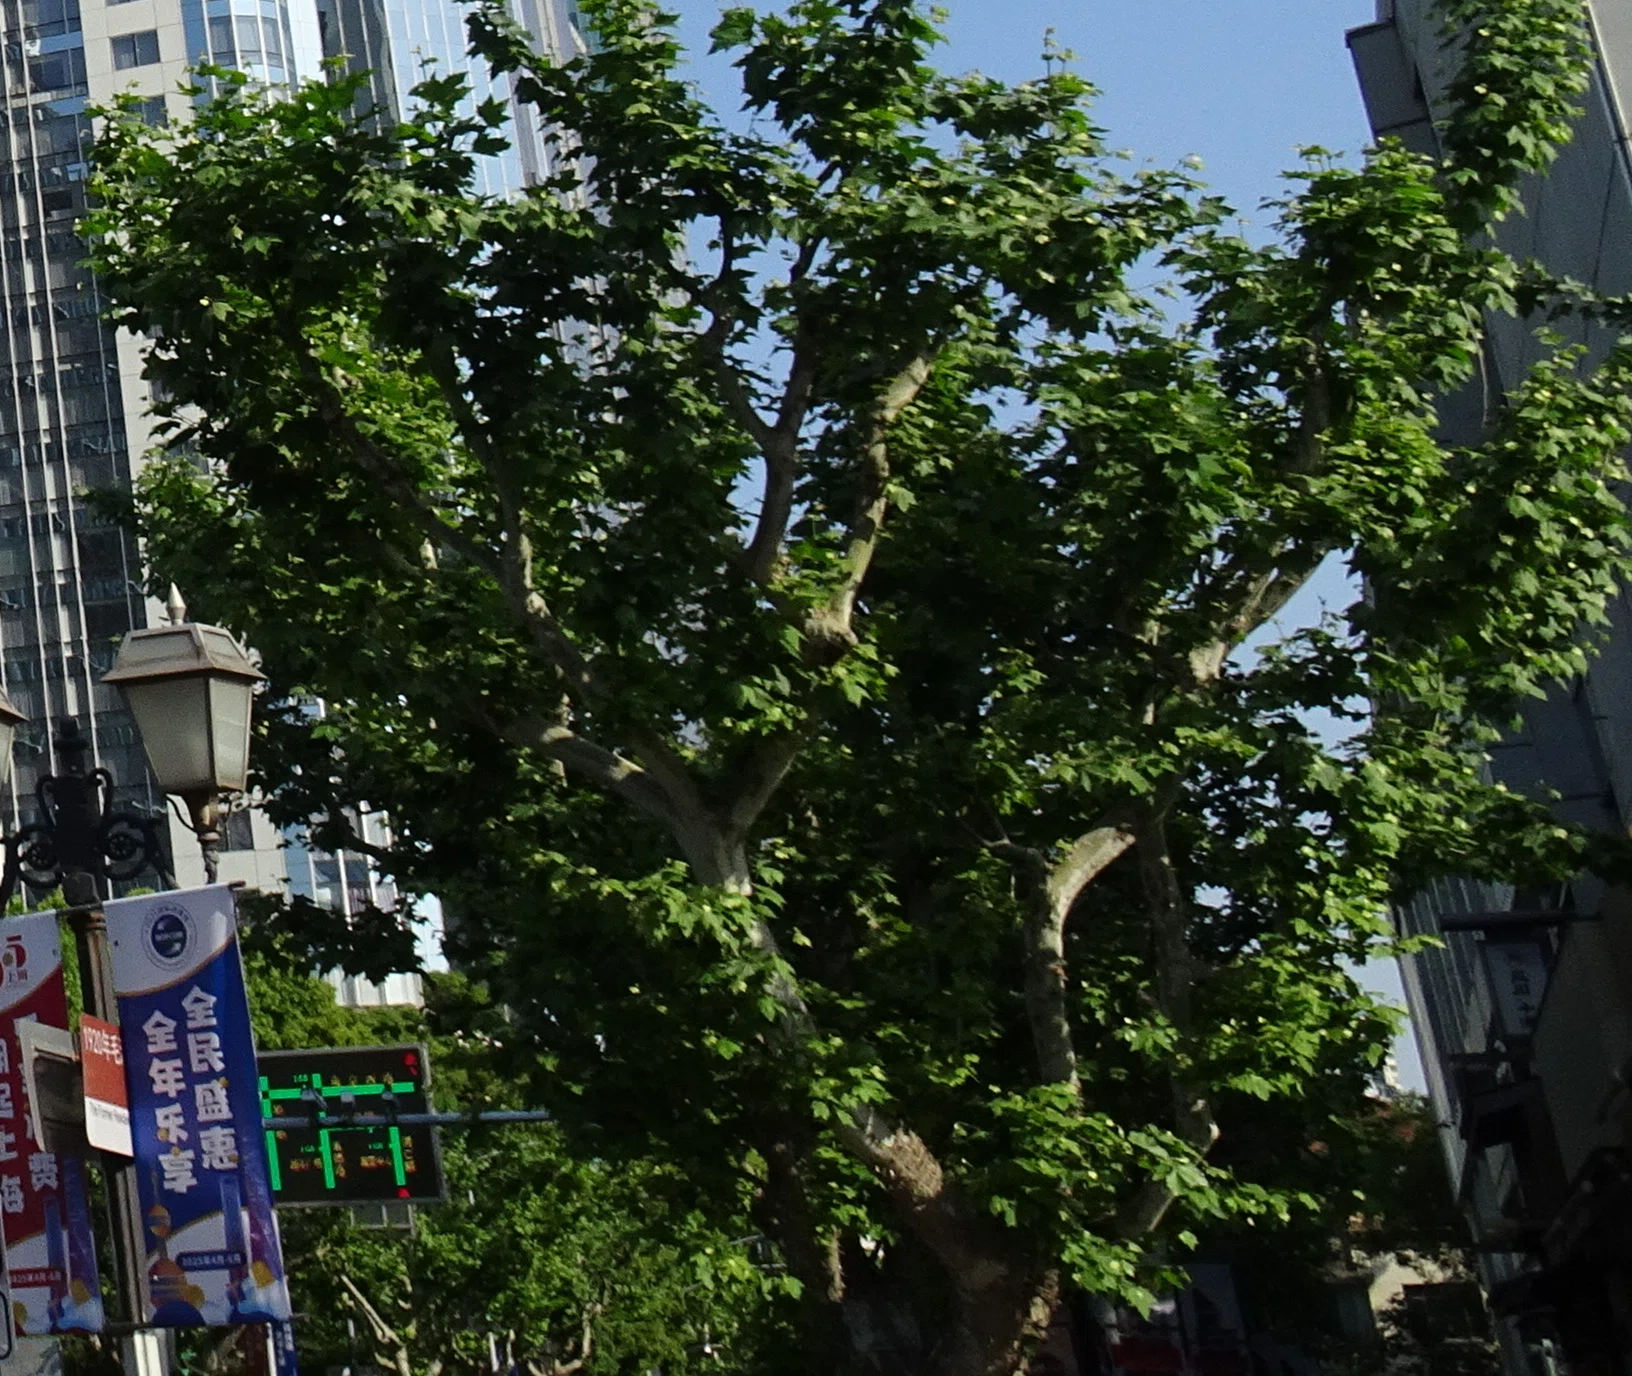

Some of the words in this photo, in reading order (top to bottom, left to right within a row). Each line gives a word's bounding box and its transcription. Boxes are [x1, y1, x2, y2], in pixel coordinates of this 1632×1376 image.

[142, 1010, 198, 1194] 全年乐享
[182, 985, 239, 1170] 全民盛惠
